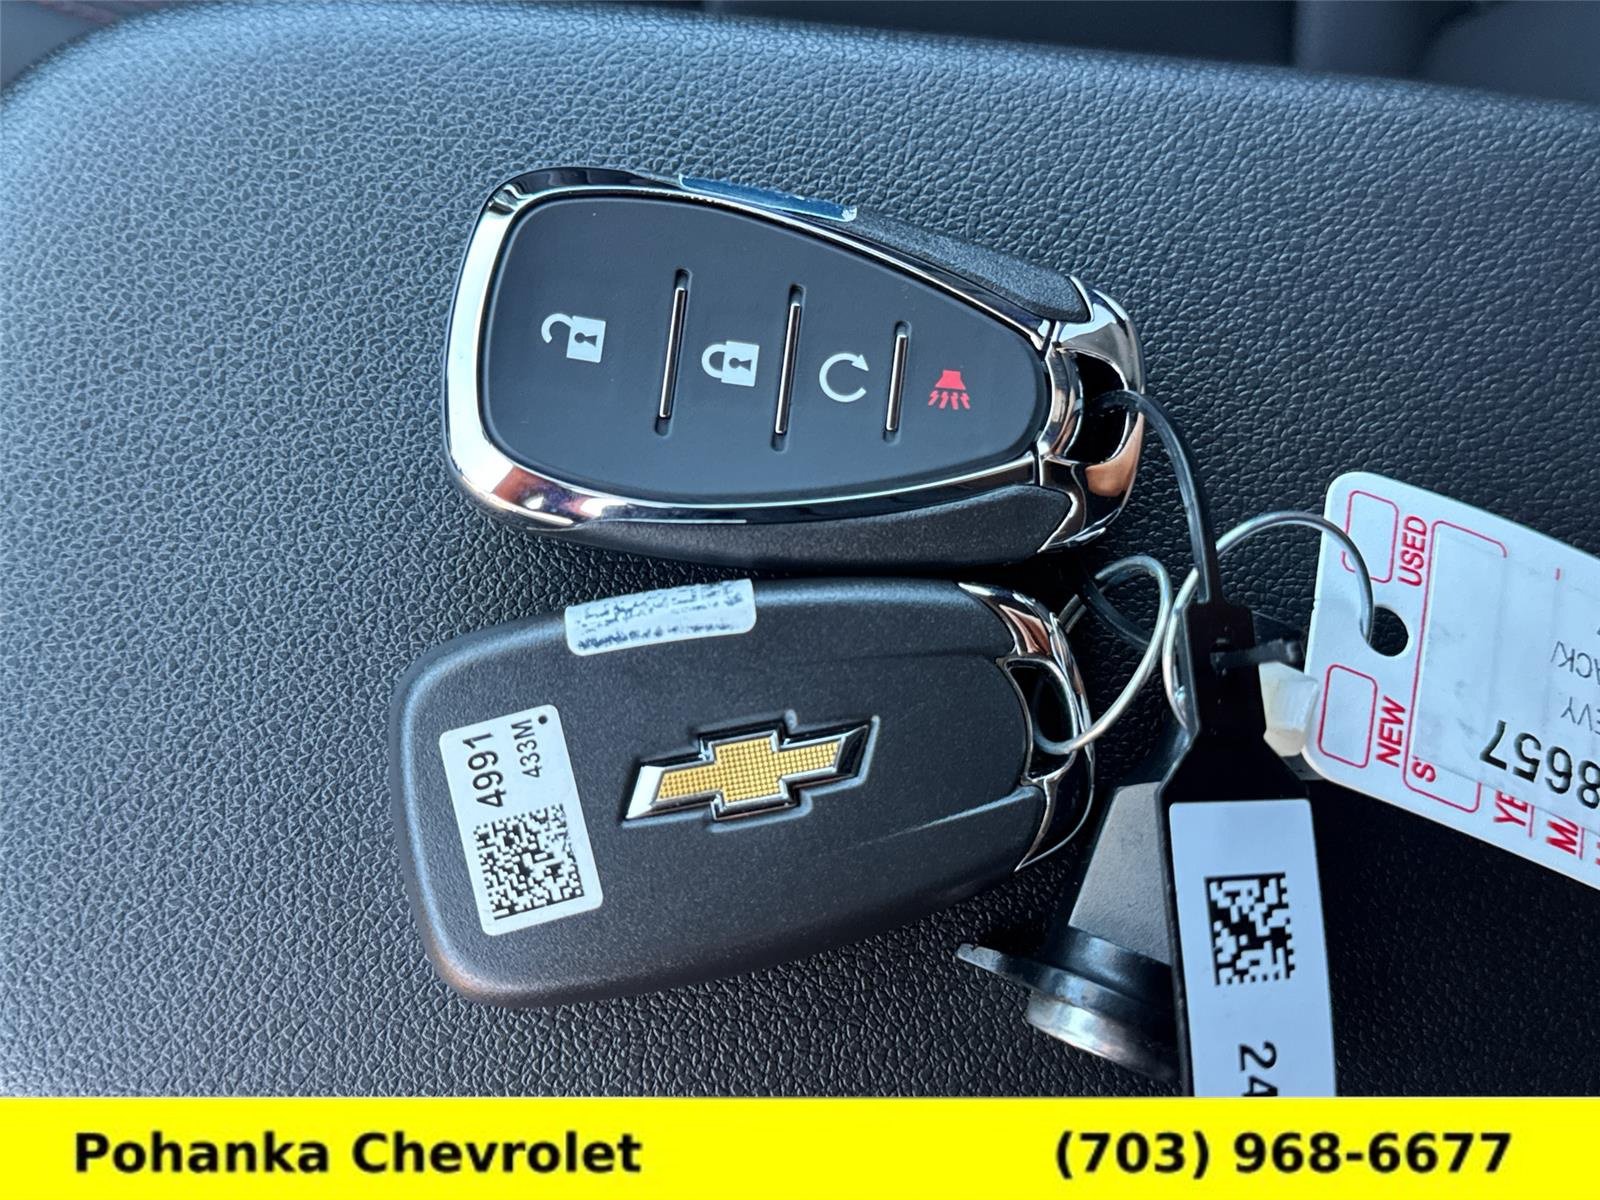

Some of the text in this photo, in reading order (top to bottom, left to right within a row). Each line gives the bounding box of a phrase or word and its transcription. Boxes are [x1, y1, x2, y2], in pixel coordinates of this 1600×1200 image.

[1397, 515, 1428, 587] USED
[511, 719, 542, 778] 433M
[1375, 696, 1406, 768] NEW
[1480, 720, 1600, 810] 8657
[463, 732, 506, 808] 4991
[1411, 756, 1436, 783] S
